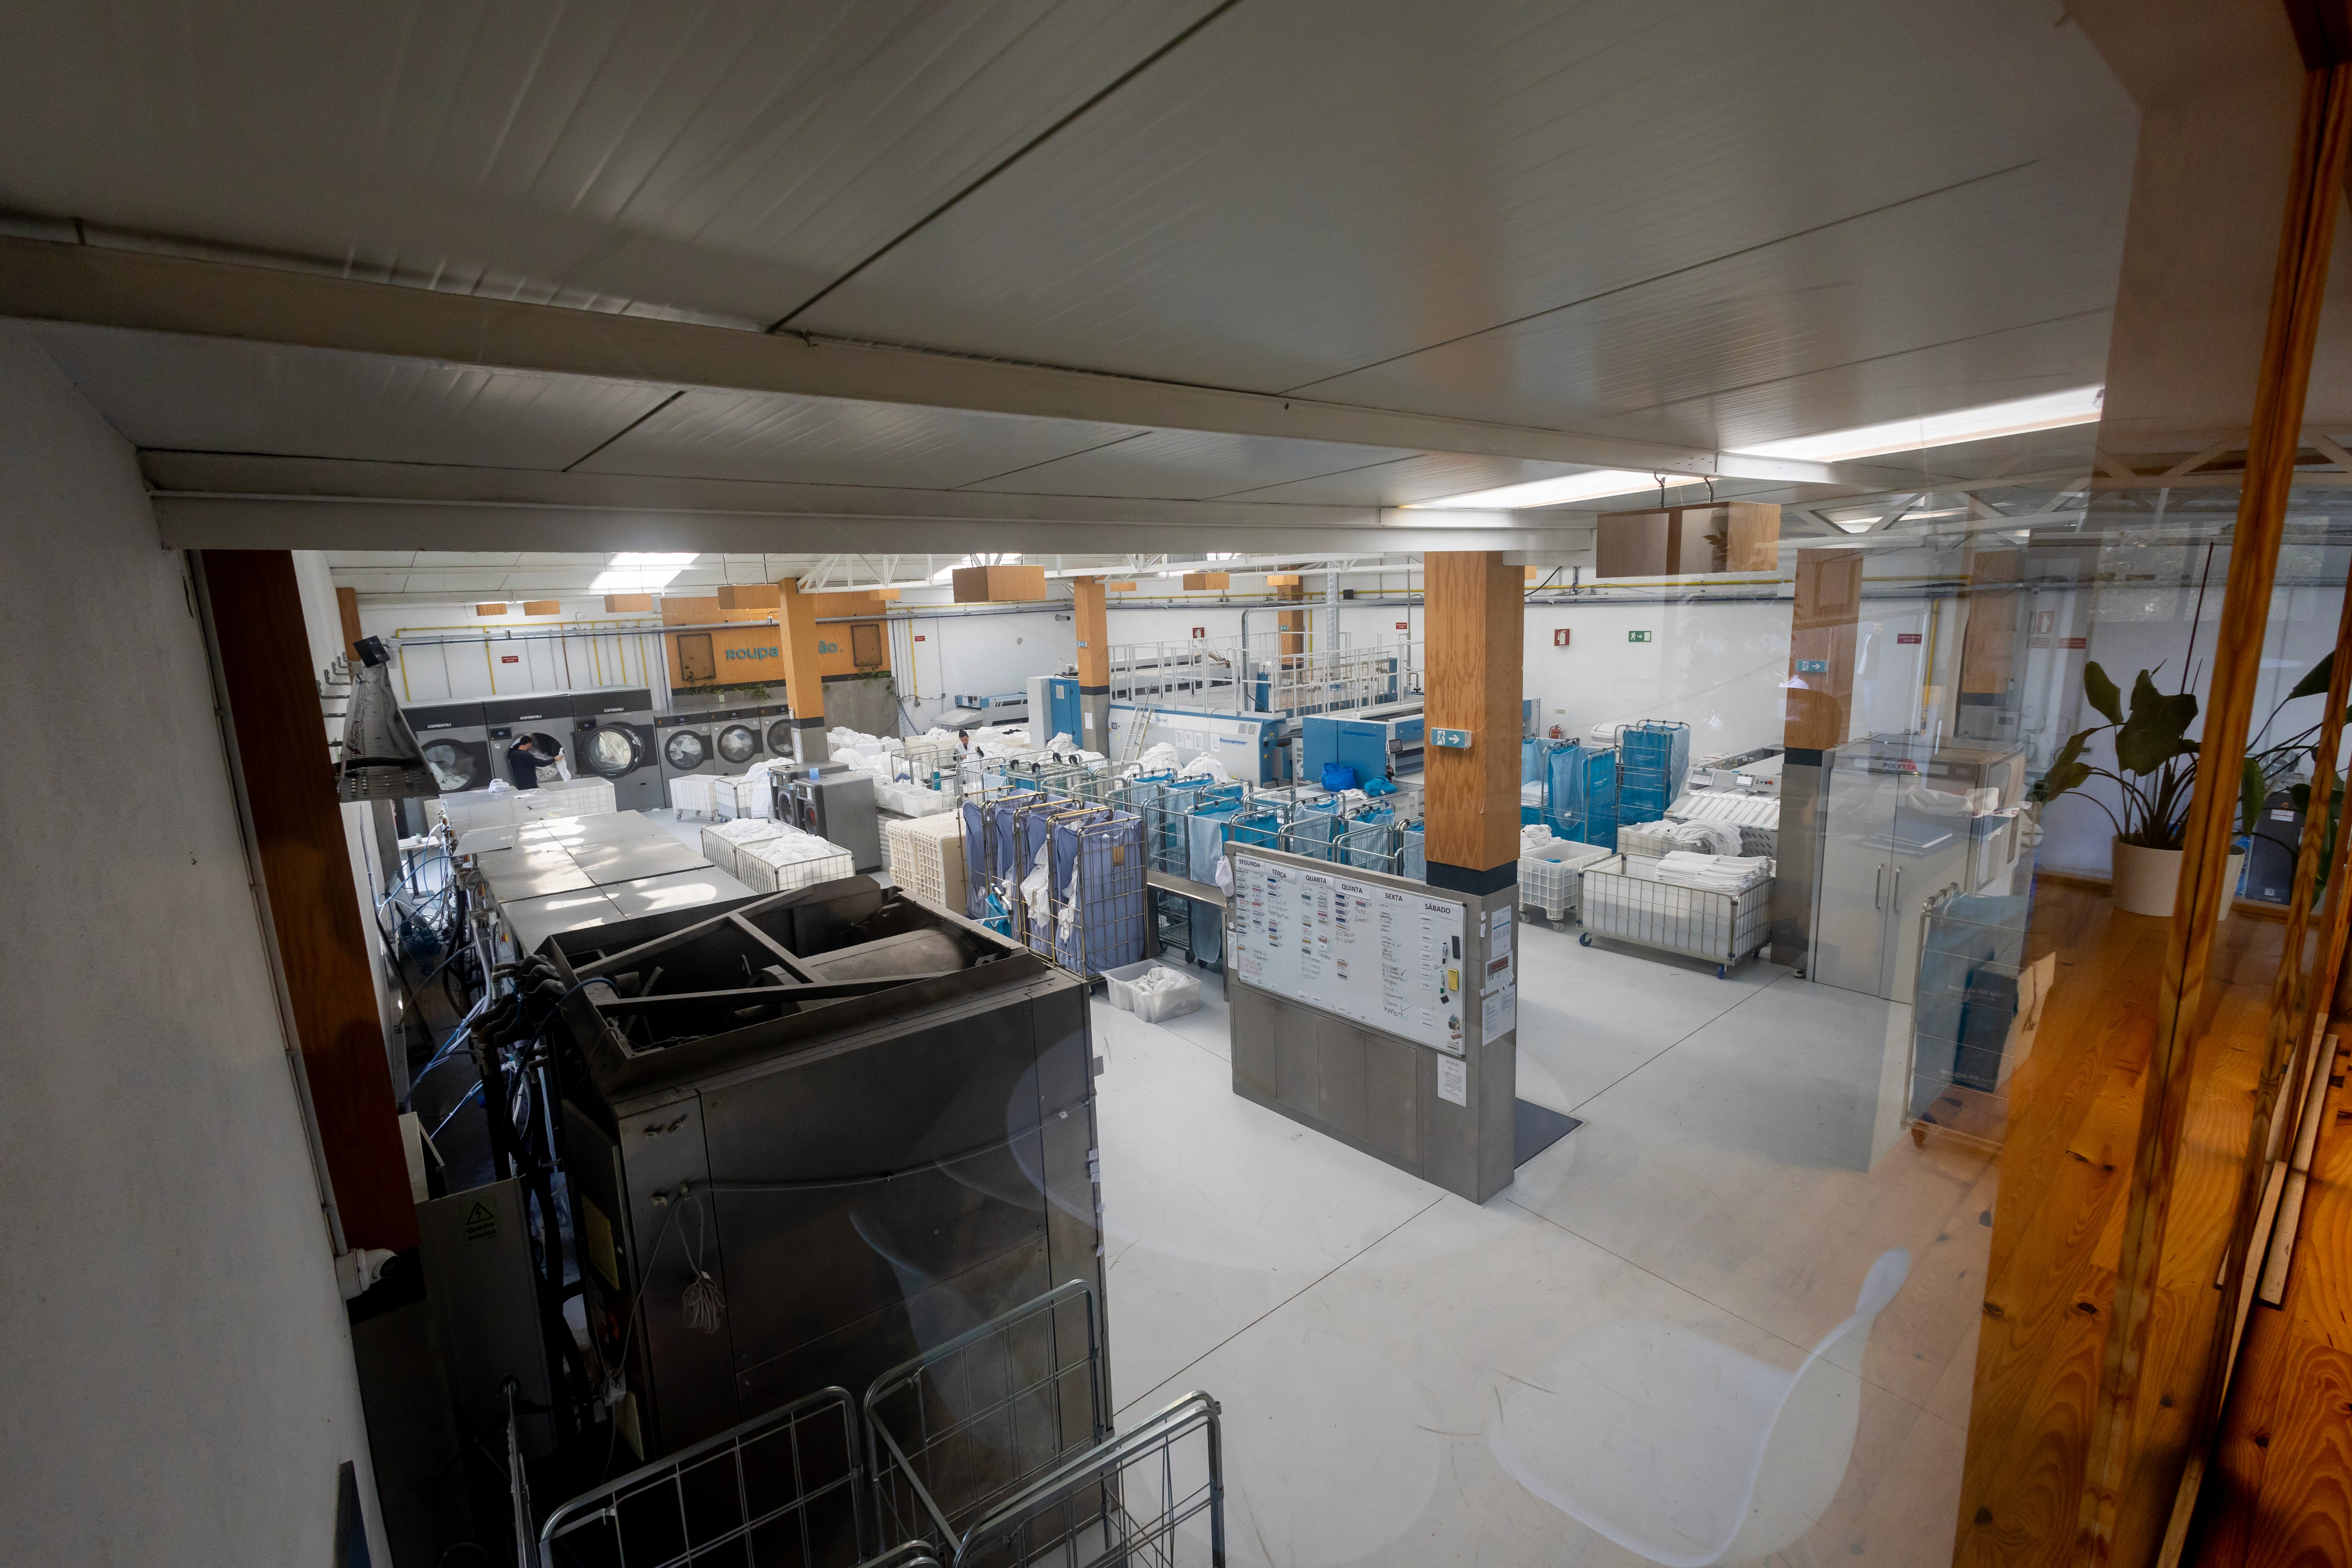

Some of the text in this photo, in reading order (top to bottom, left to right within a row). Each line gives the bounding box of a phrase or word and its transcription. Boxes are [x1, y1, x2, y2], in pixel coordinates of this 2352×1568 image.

[1239, 859, 1260, 868] SEGUNDA
[1272, 869, 1286, 878] TERÇA
[1306, 875, 1327, 884] QUARTA
[1341, 884, 1363, 894] QUINTA
[1385, 893, 1403, 902] SEXTA
[1425, 903, 1450, 914] SÁBADO
[467, 1222, 495, 1233] Quadro
